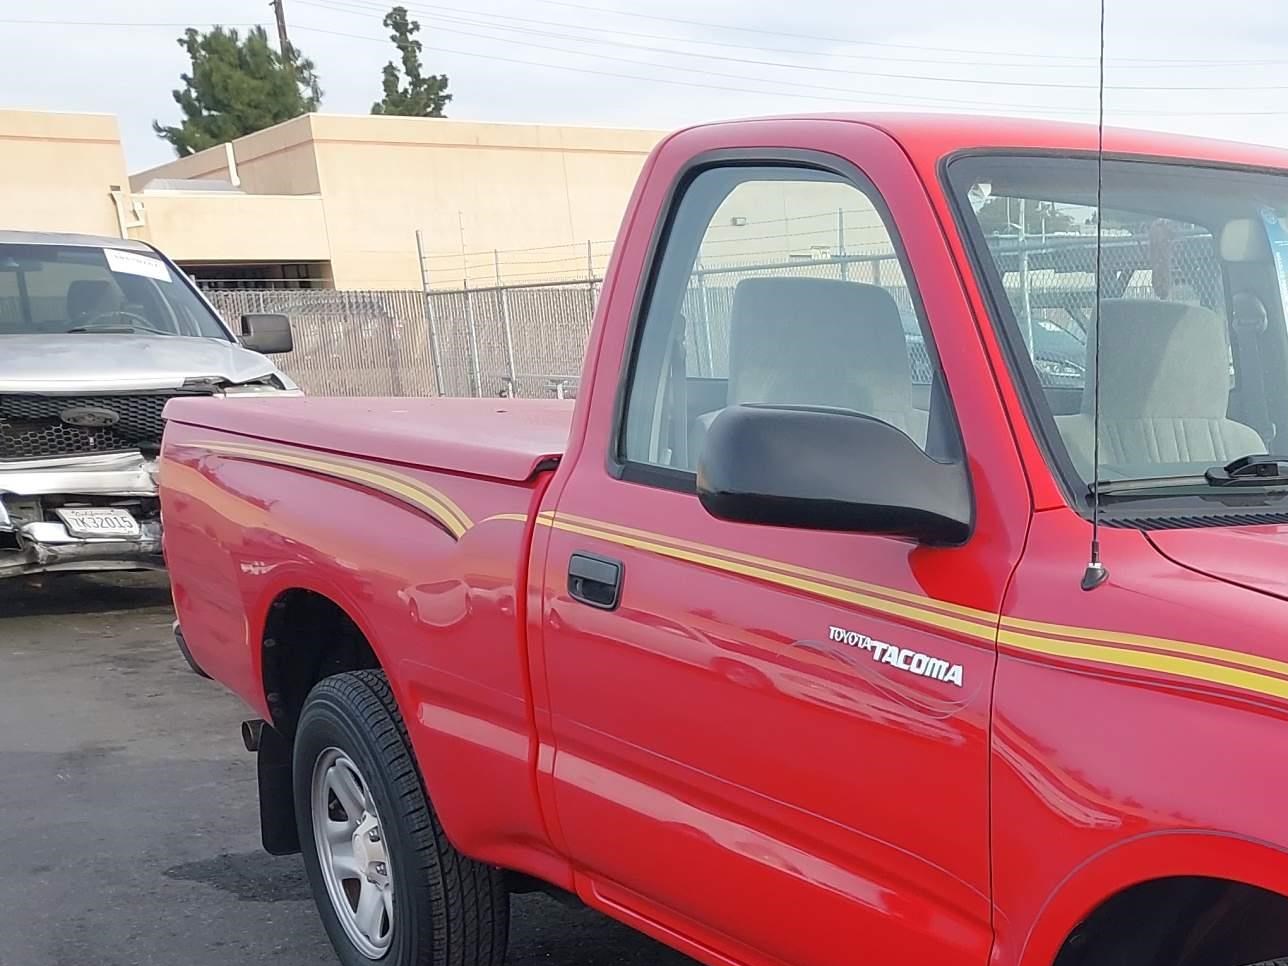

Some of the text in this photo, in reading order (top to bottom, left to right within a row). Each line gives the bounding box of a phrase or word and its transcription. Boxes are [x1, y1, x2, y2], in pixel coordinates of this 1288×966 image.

[68, 516, 133, 529] 7K32015
[829, 625, 963, 687] TOYOTA TACOMA
